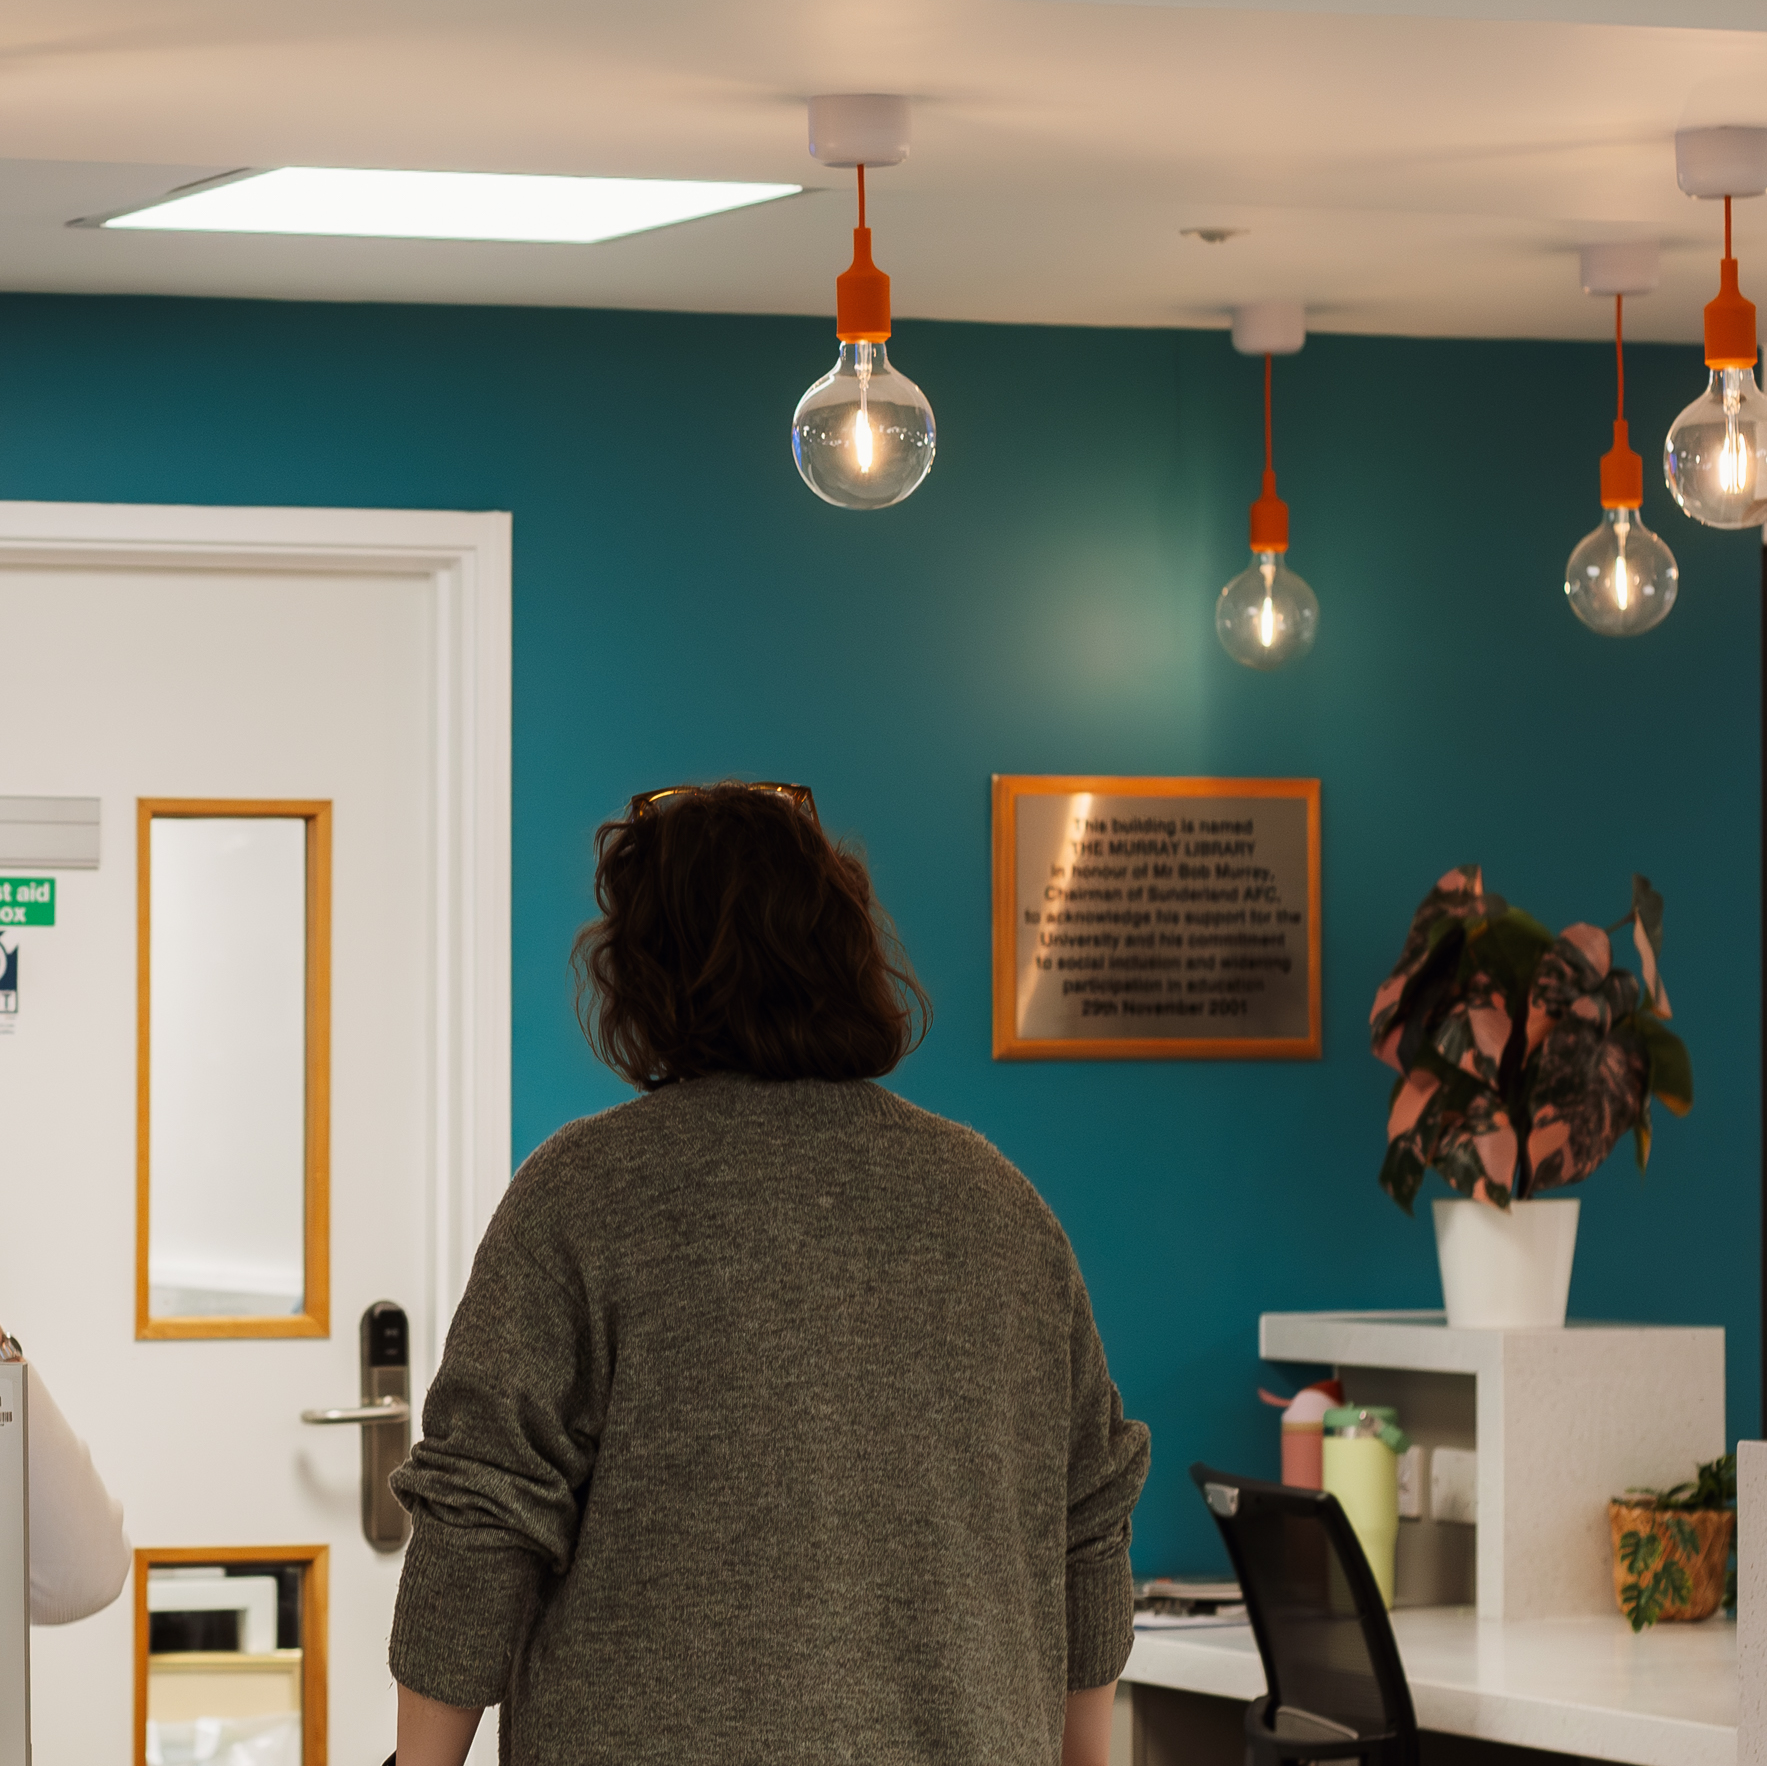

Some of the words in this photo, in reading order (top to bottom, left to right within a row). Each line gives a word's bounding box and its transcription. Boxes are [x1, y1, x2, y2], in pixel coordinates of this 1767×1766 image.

[1109, 840, 1180, 856] MURRAY
[1184, 840, 1255, 856] LIBRARY
[16, 882, 50, 903] aid
